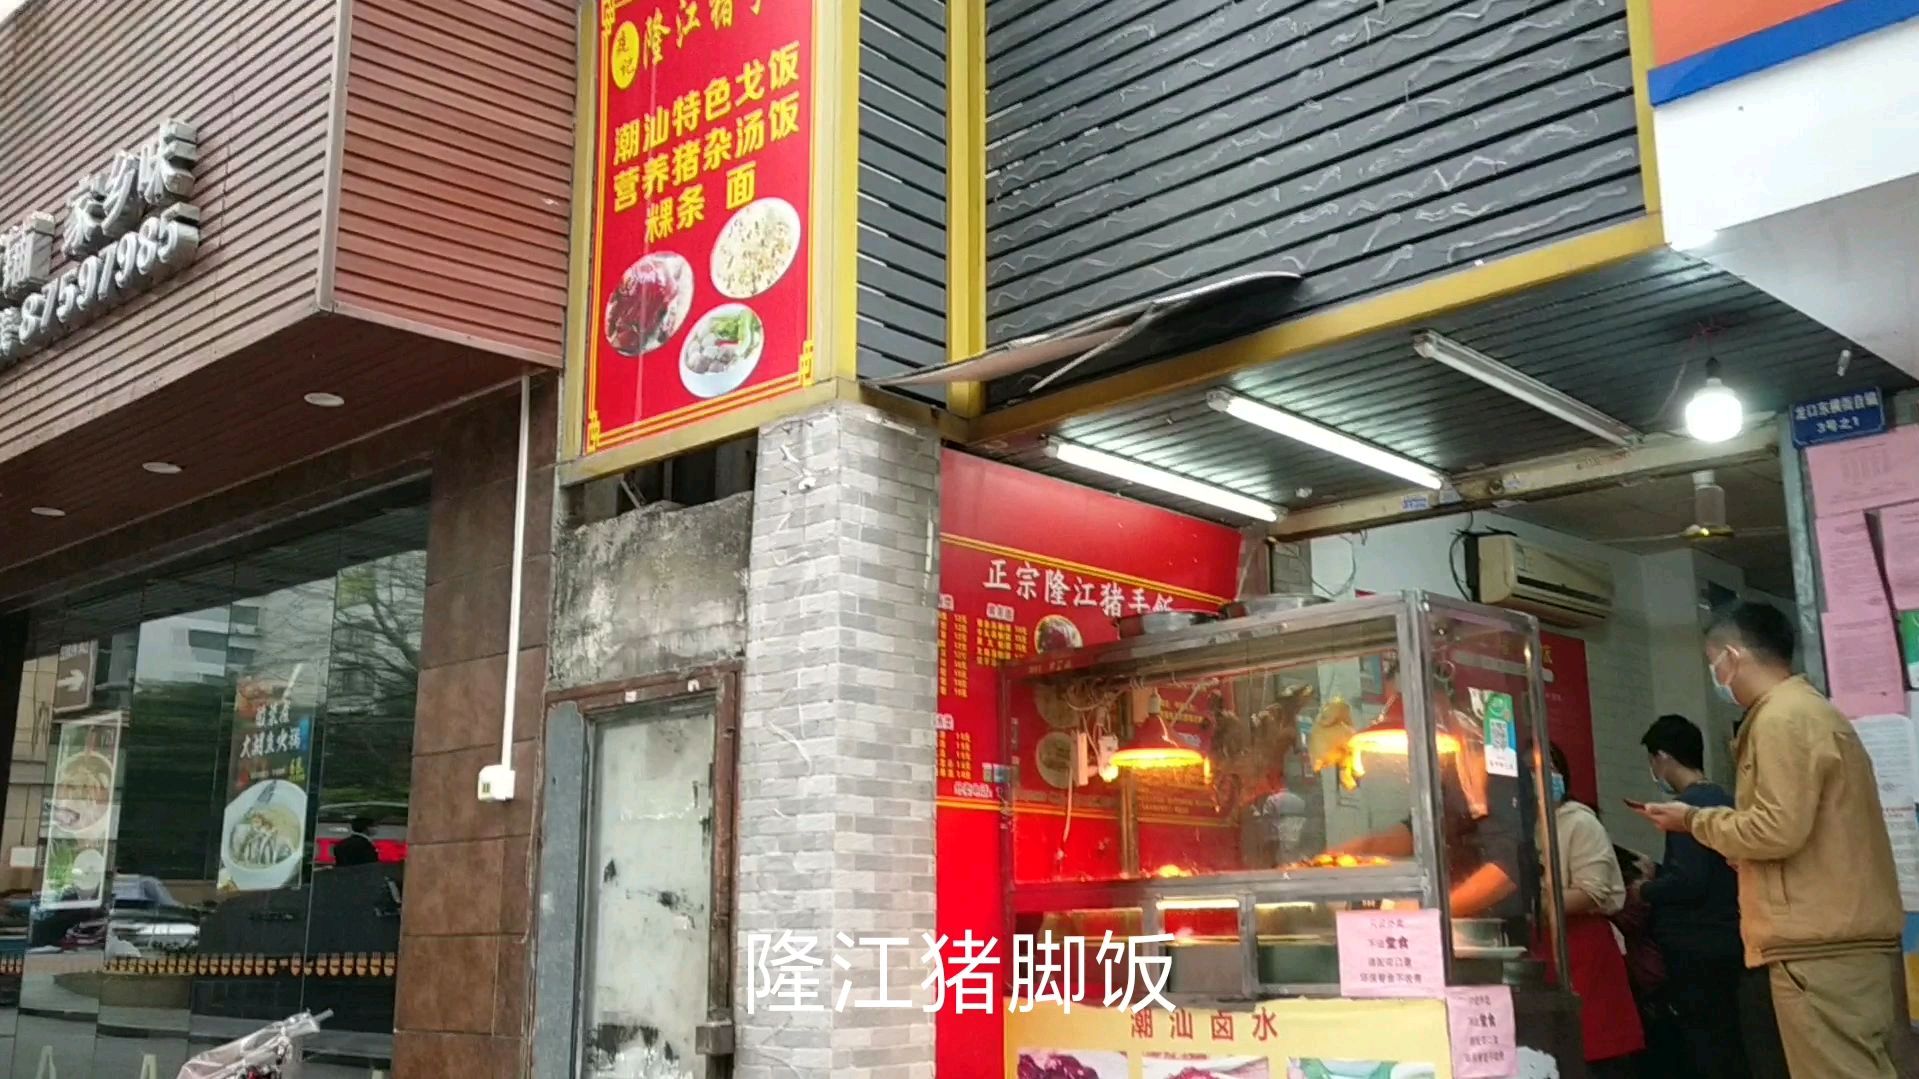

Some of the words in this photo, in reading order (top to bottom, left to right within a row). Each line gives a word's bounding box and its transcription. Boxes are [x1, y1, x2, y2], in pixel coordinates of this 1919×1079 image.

[613, 92, 800, 213] 营养猪杂汤饭
[725, 161, 756, 210] 面
[1130, 1006, 1279, 1041] 潮汕卤水
